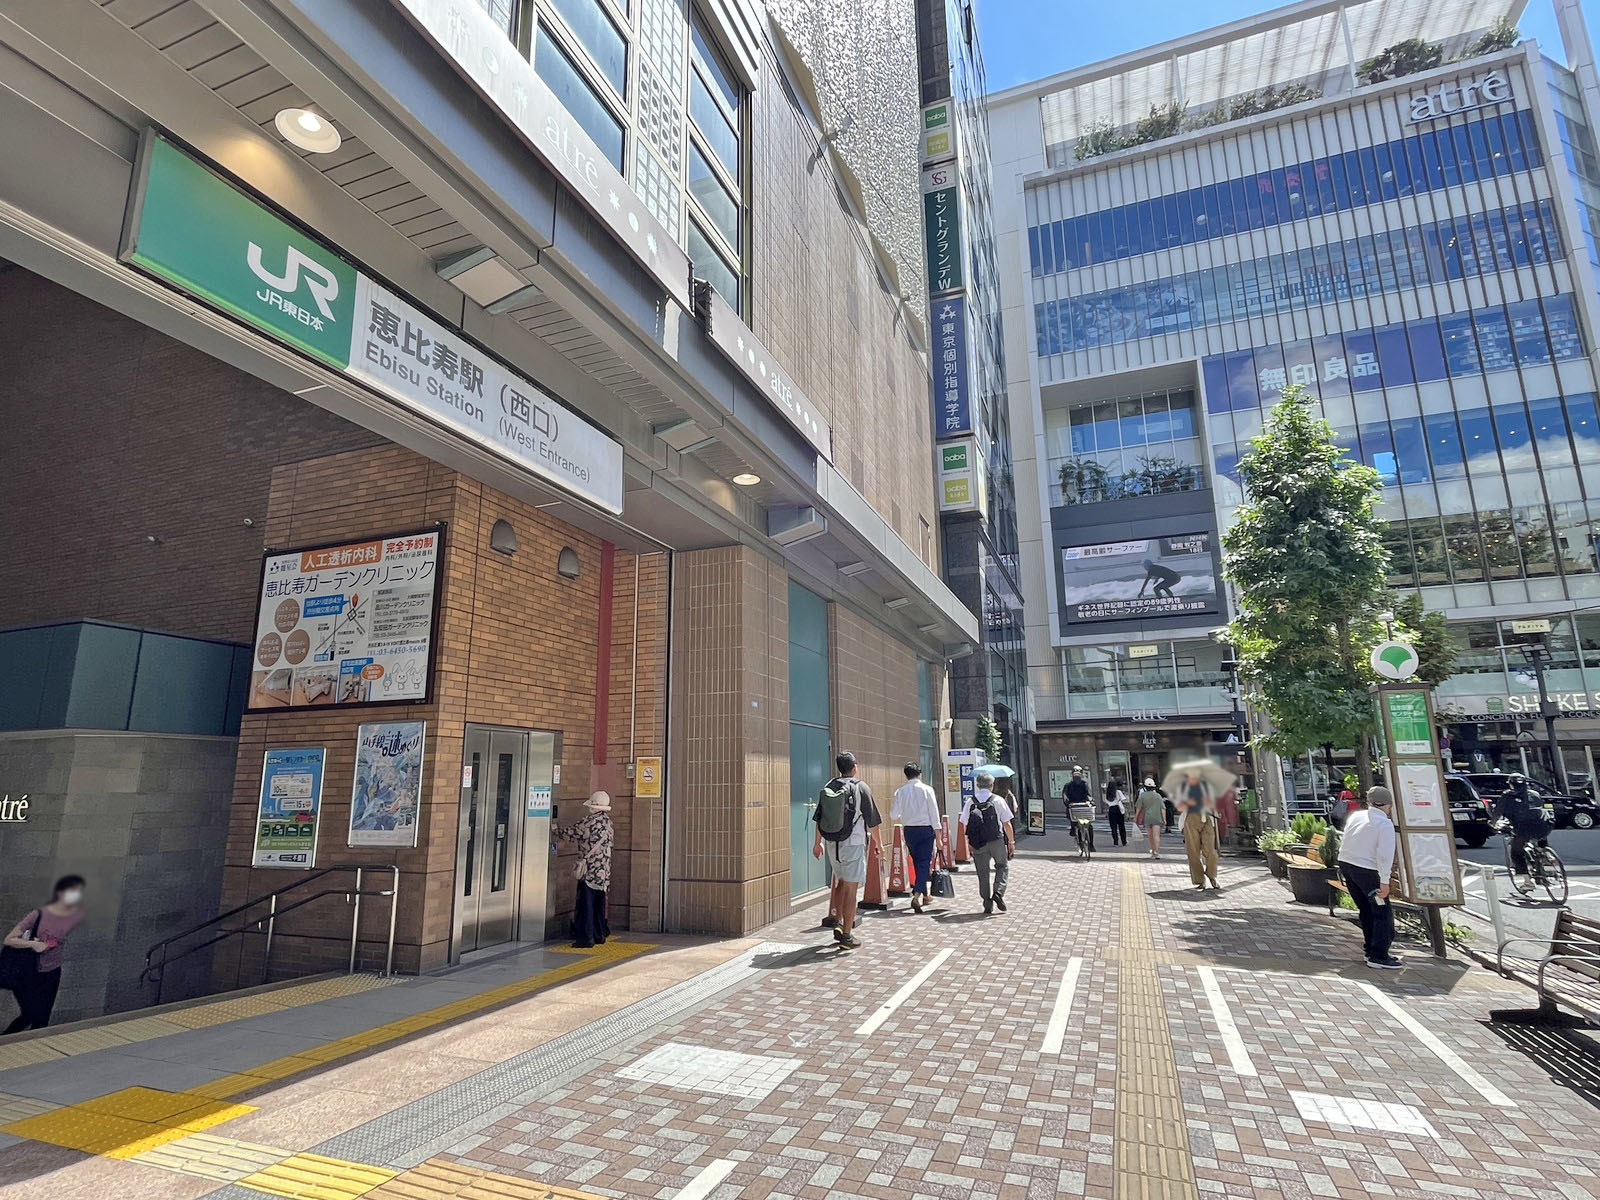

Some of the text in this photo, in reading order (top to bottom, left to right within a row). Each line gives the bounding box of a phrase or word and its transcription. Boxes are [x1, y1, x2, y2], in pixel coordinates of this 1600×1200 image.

[1409, 70, 1512, 122] atré
[544, 116, 600, 195] atré
[934, 192, 952, 291] セントグランデW
[247, 241, 341, 322] JR
[256, 287, 325, 333] JR東日本
[367, 299, 486, 400] 恵比寿駅
[941, 322, 960, 429] 東京個別指導学院
[1259, 352, 1381, 392] 無印良品
[365, 340, 591, 485] Ebisu Station (West Entrance)
[303, 546, 378, 570] 人工透析内科
[386, 536, 434, 554] 完全予約制
[265, 561, 435, 598] 恵比寿ガーデンクリニック
[1508, 693, 1590, 713] SHKE
